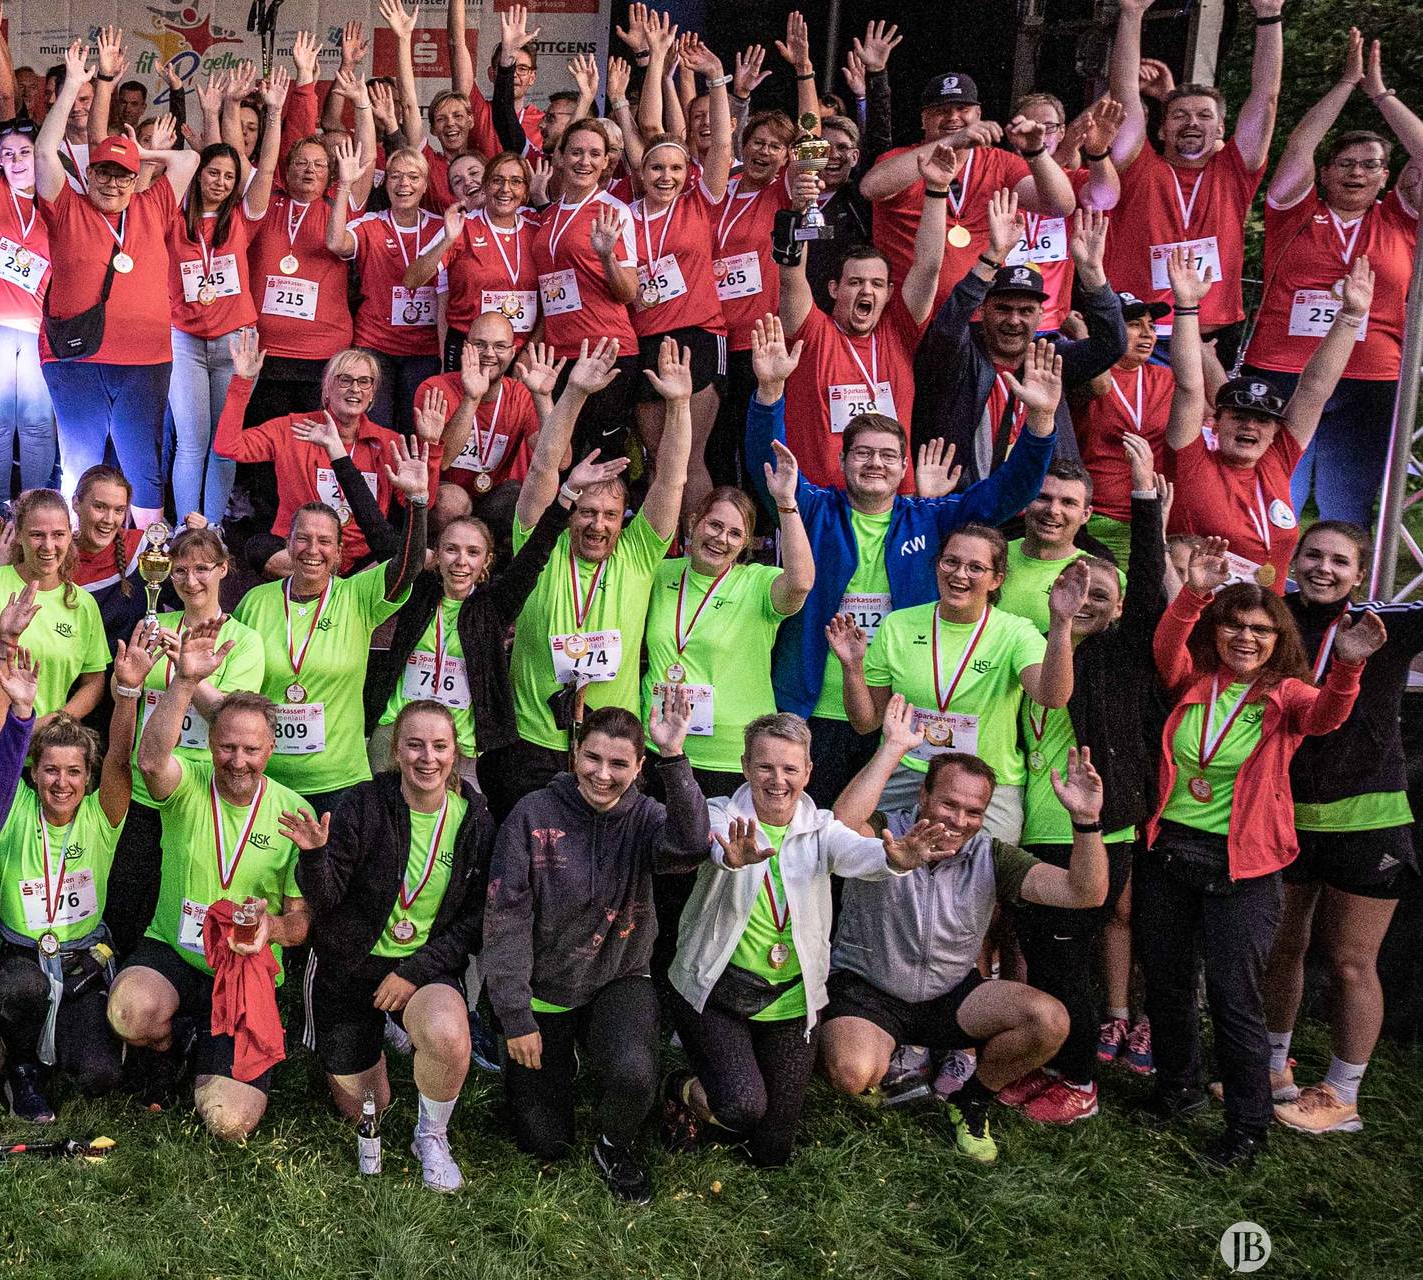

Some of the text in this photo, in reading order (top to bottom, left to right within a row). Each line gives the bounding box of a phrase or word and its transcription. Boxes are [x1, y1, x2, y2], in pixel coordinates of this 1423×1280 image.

[529, 41, 597, 53] ÖTTGENS
[135, 51, 158, 74] fit
[1018, 236, 1051, 252] 26
[197, 272, 225, 287] 245
[276, 291, 305, 306] 215
[1309, 308, 1335, 323] 25
[460, 444, 481, 458] 24
[901, 535, 926, 556] KW
[56, 623, 72, 634] HSK
[419, 654, 457, 668] Sparsen
[913, 710, 956, 723] Sparkassen
[250, 832, 271, 846] HSK
[441, 852, 453, 863] HS
